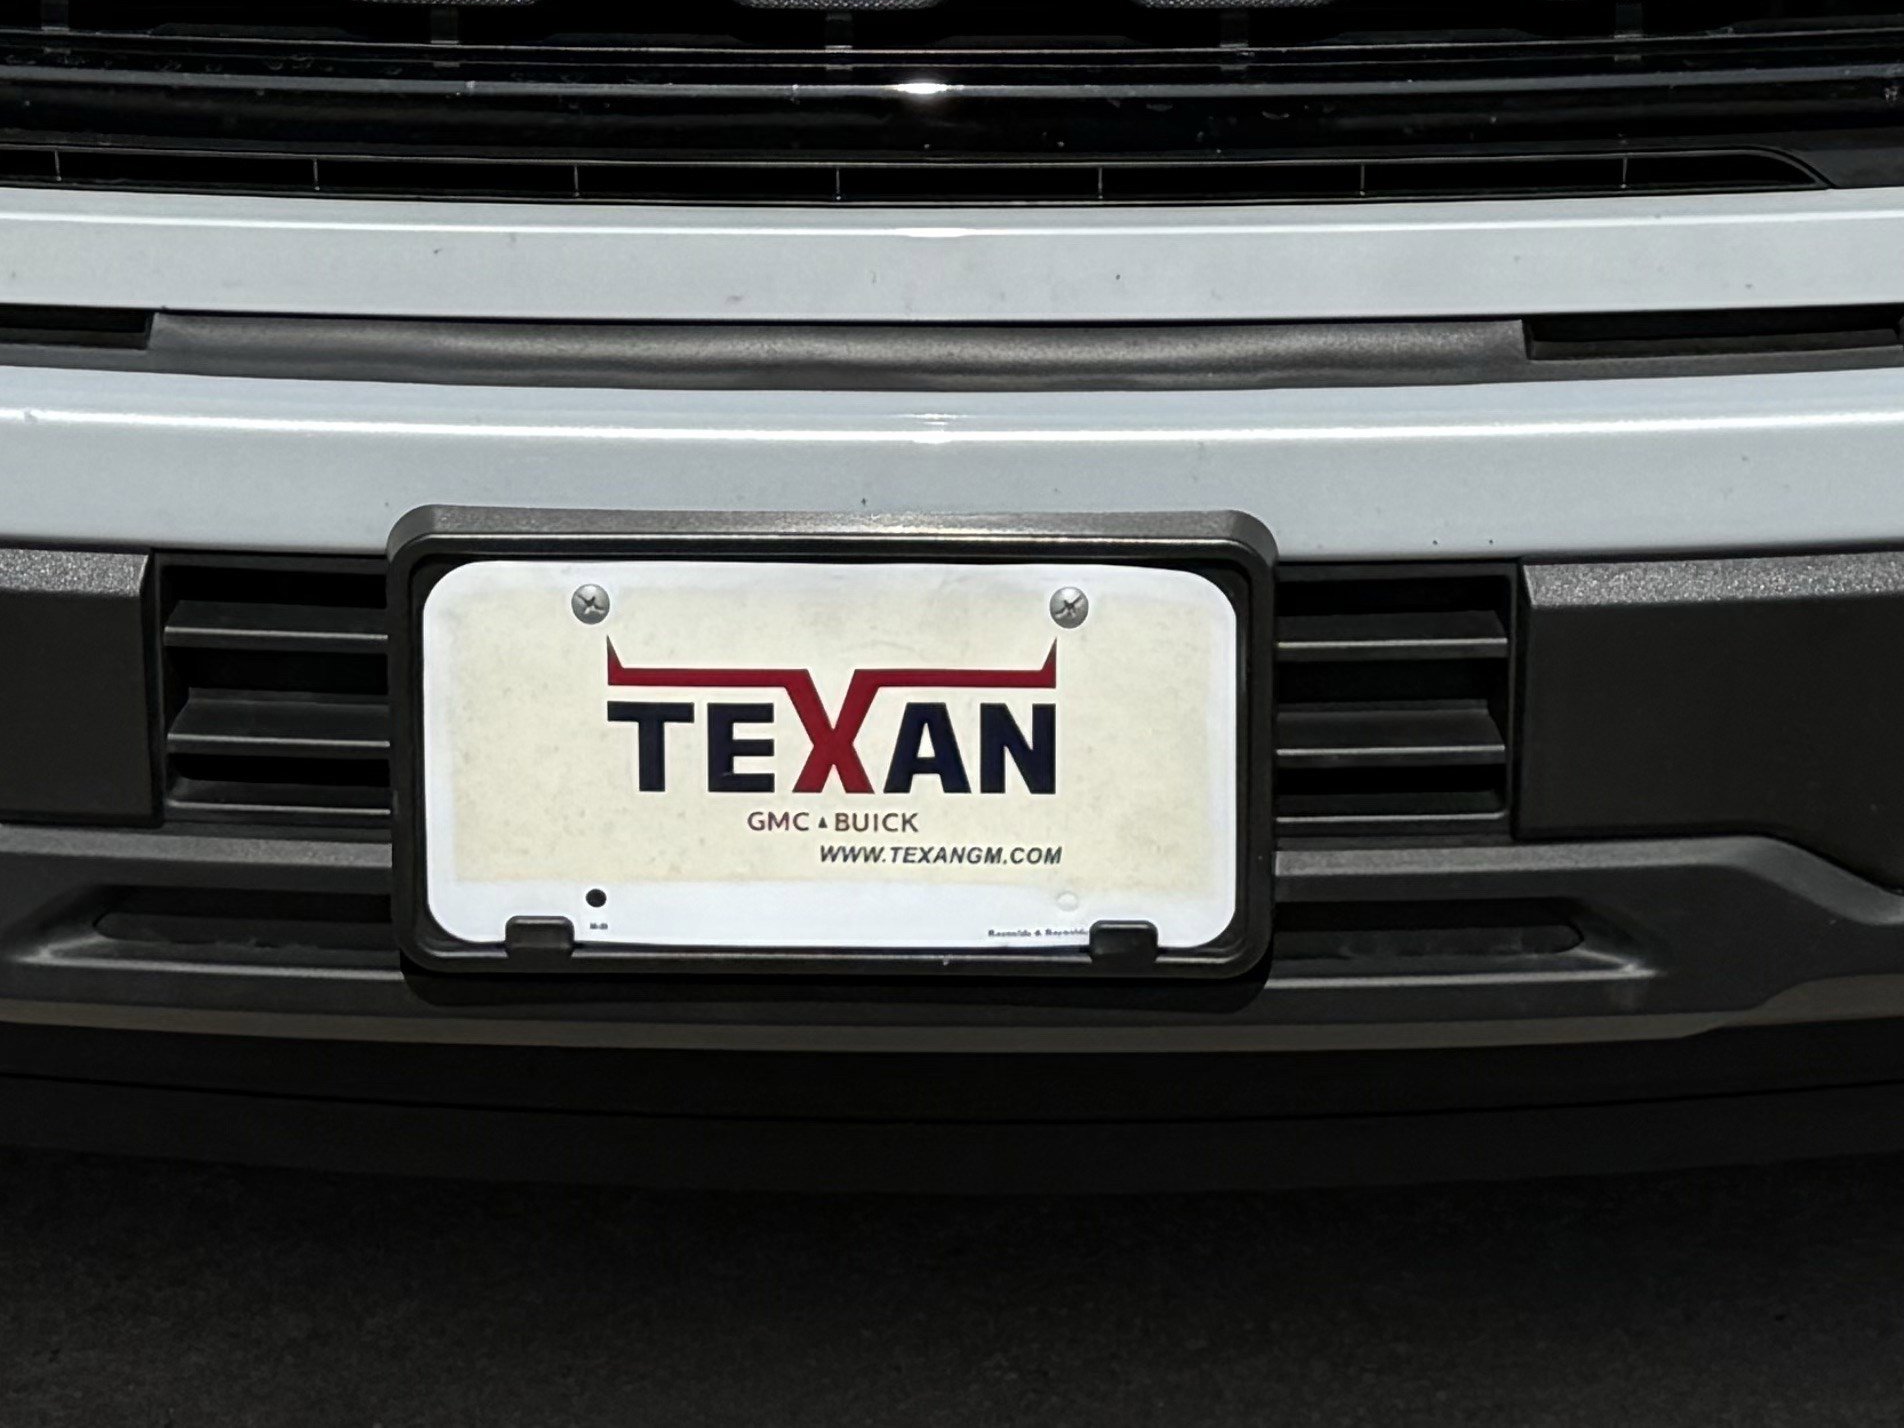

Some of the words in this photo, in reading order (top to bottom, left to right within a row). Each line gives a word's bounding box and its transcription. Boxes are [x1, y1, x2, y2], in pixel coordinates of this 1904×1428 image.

[606, 666, 1057, 795] TEXAN
[747, 811, 810, 832] GMC
[834, 812, 919, 833] BUICK
[819, 844, 1063, 865] WWW.TEXANGM.COM
